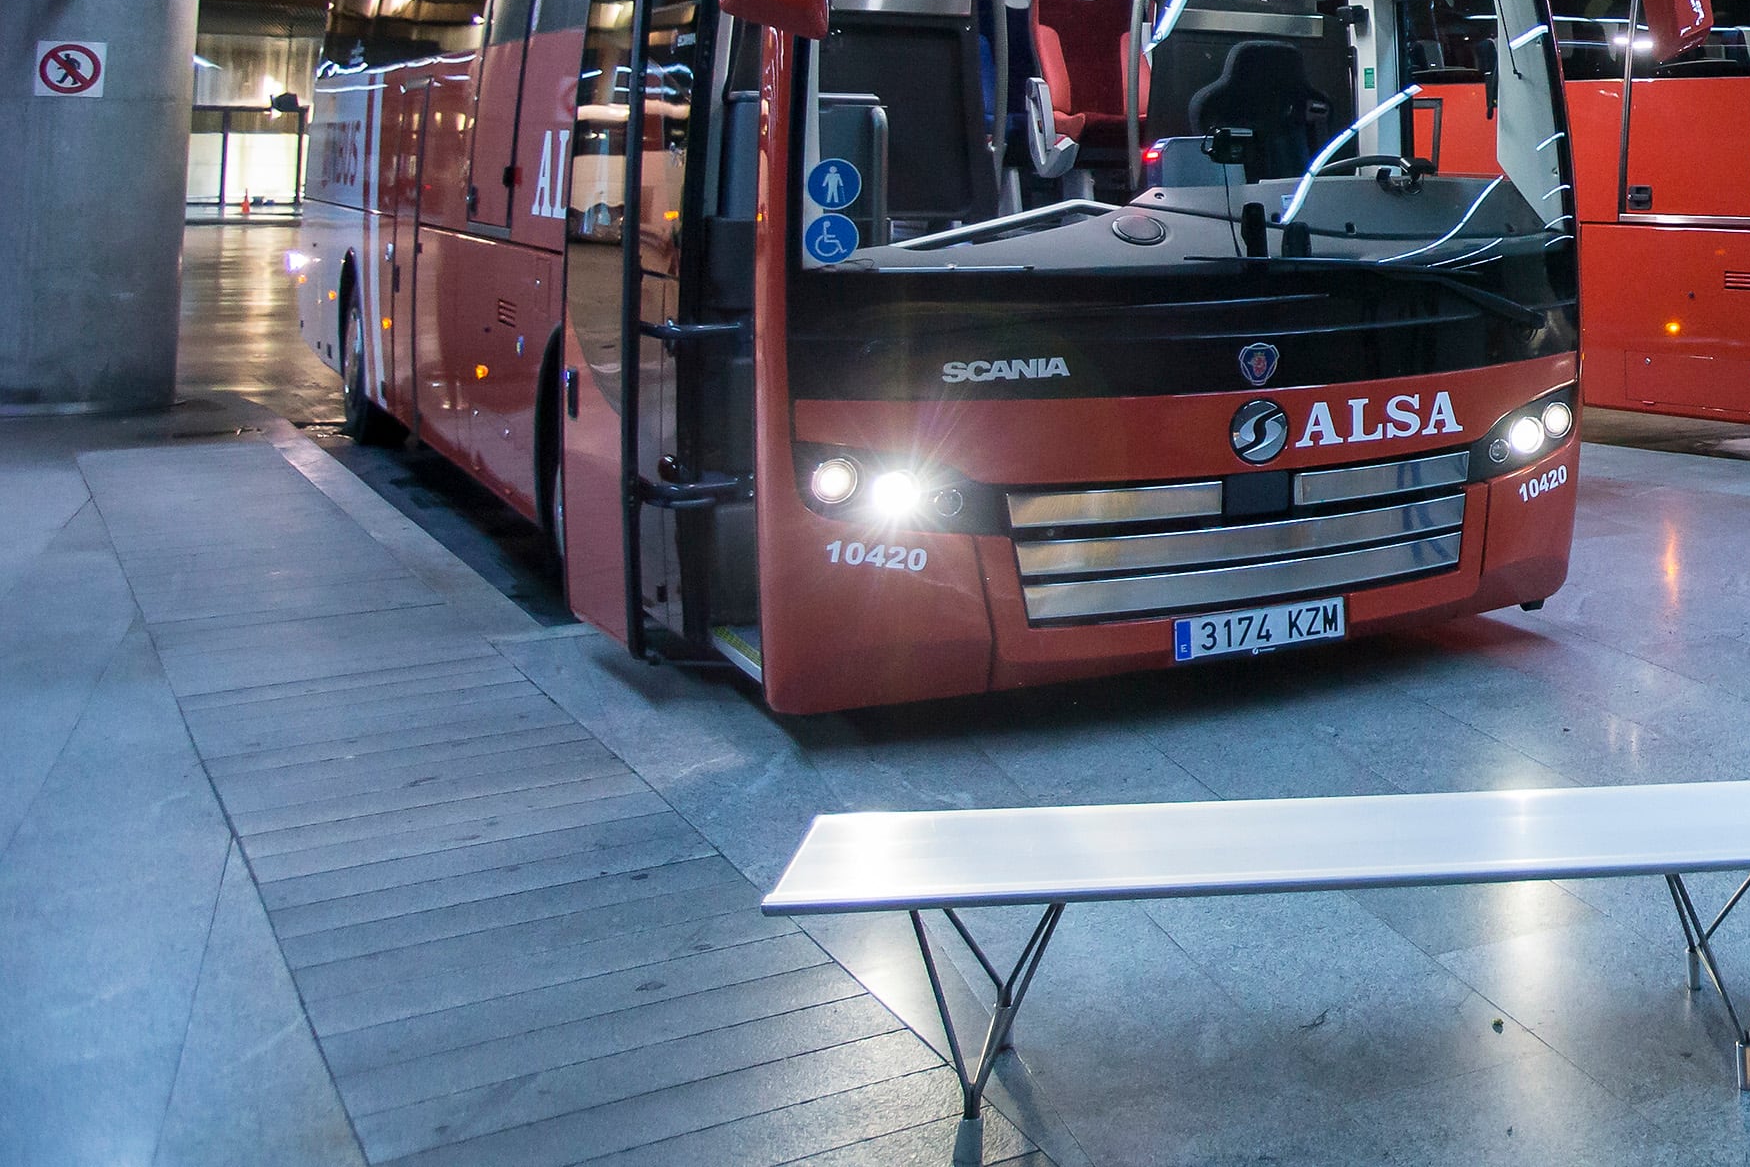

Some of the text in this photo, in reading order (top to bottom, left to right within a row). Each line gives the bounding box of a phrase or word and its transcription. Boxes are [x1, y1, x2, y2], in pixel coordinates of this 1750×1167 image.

[941, 356, 1071, 383] SCANIA
[1295, 391, 1463, 447] ALSA
[1519, 464, 1568, 502] 10420
[826, 540, 928, 571] 10420
[1200, 614, 1273, 651] 3174
[1288, 603, 1339, 639] KZM
